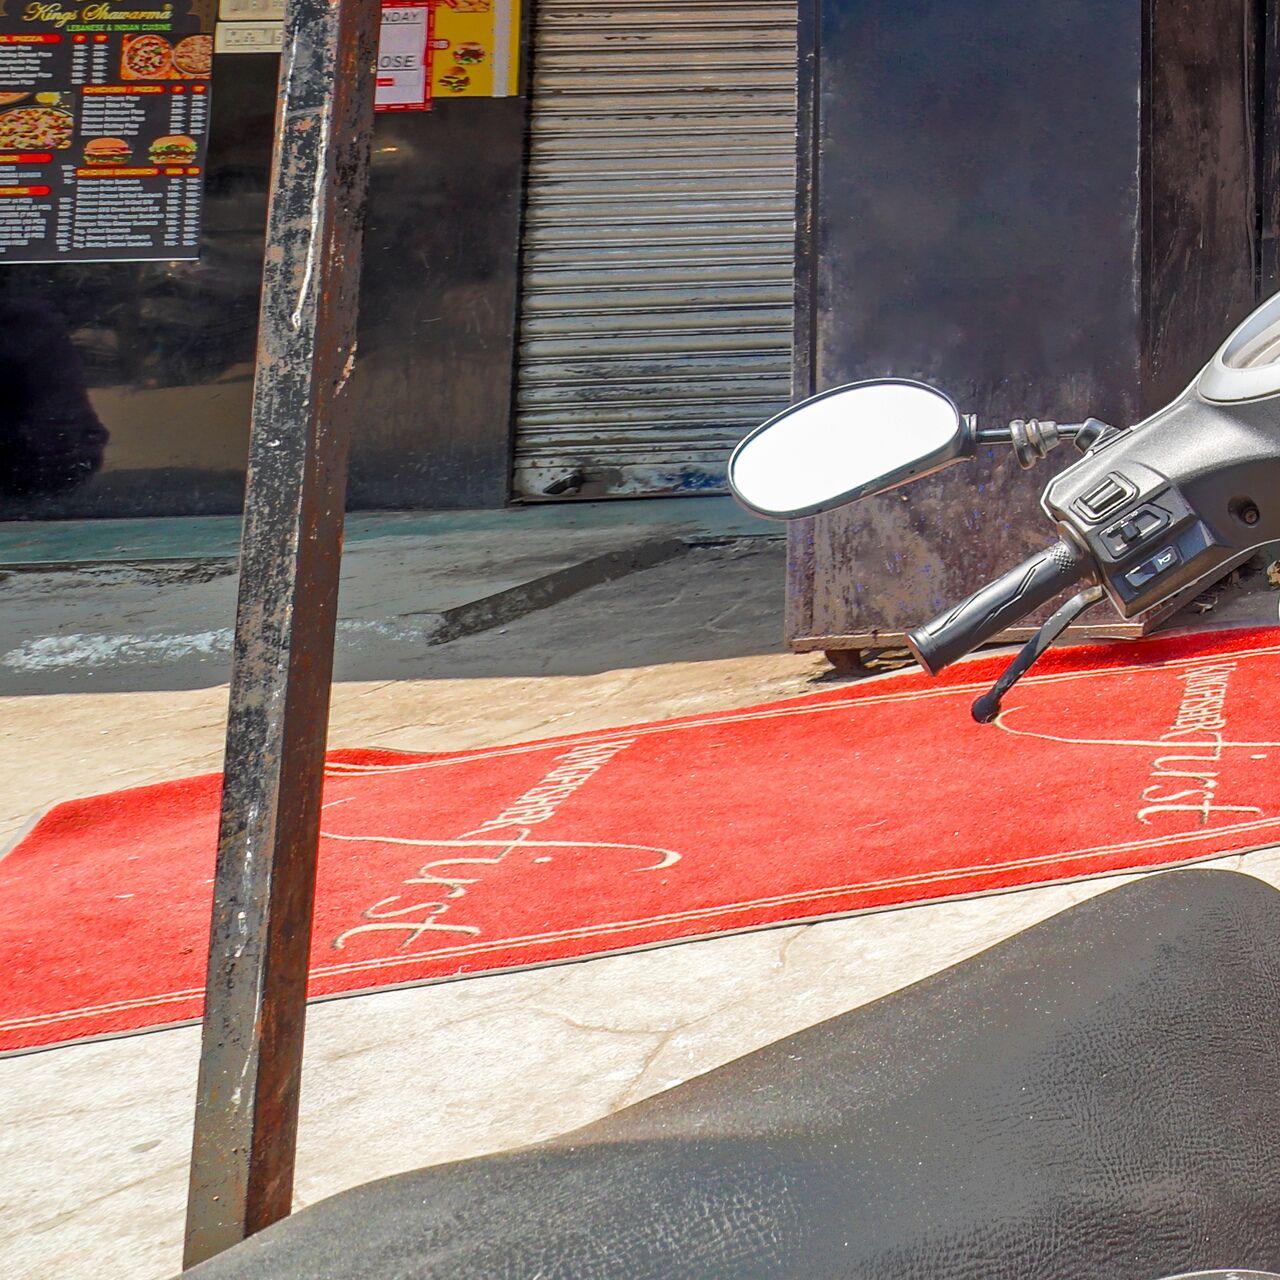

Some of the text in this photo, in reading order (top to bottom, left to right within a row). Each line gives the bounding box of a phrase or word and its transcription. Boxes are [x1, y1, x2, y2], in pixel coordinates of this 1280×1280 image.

[22, 1, 78, 28] Kings
[382, 11, 421, 23] NDAY
[380, 55, 415, 68] OSE
